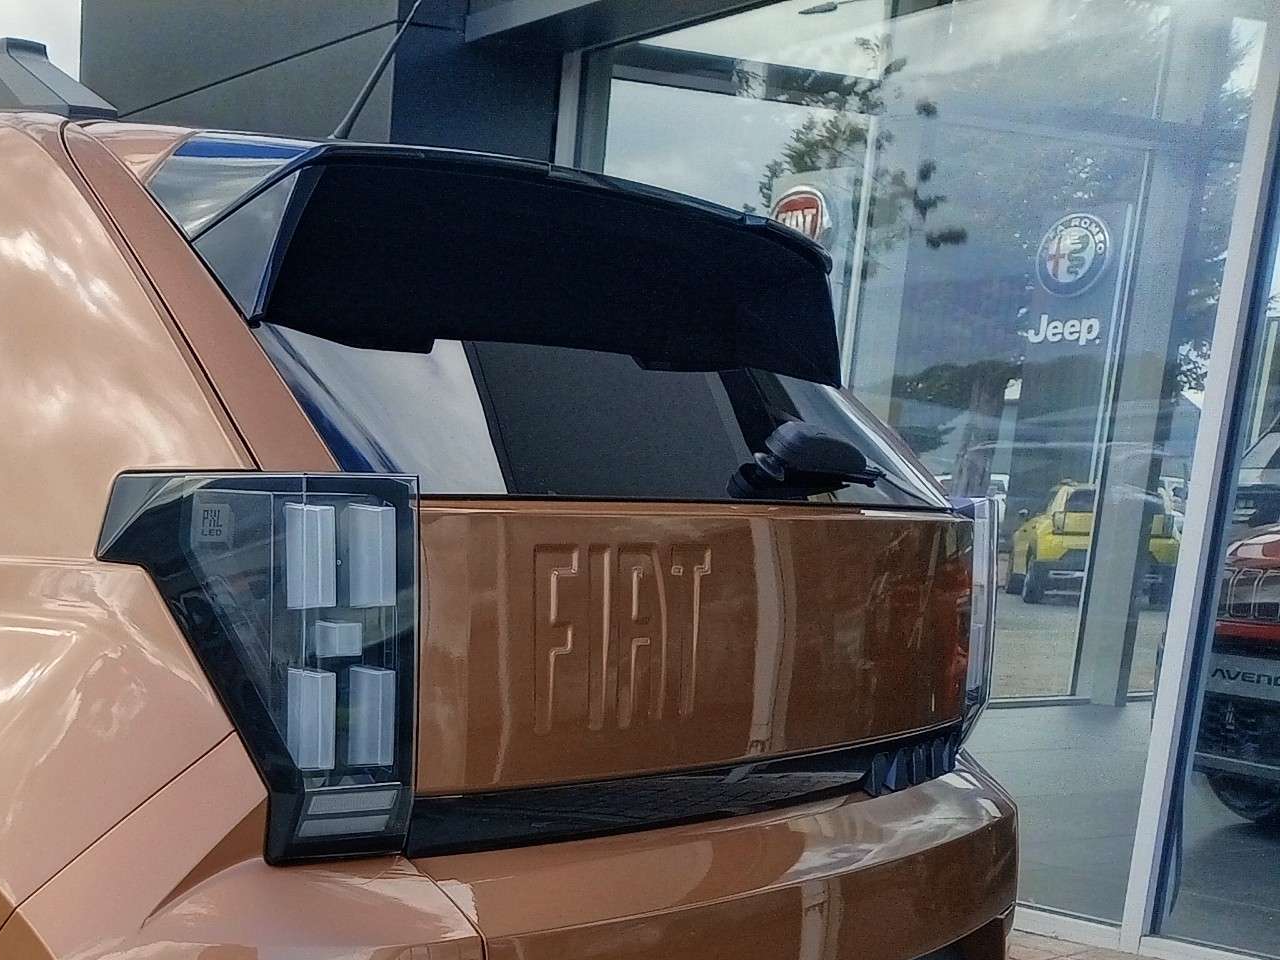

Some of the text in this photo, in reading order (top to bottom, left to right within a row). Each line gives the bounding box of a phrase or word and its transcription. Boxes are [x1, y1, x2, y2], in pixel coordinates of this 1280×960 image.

[1070, 216, 1105, 254] ROMEO
[1027, 314, 1100, 345] Jeep
[201, 529, 222, 537] LED
[202, 509, 222, 527] PXL
[533, 543, 712, 735] FIAT
